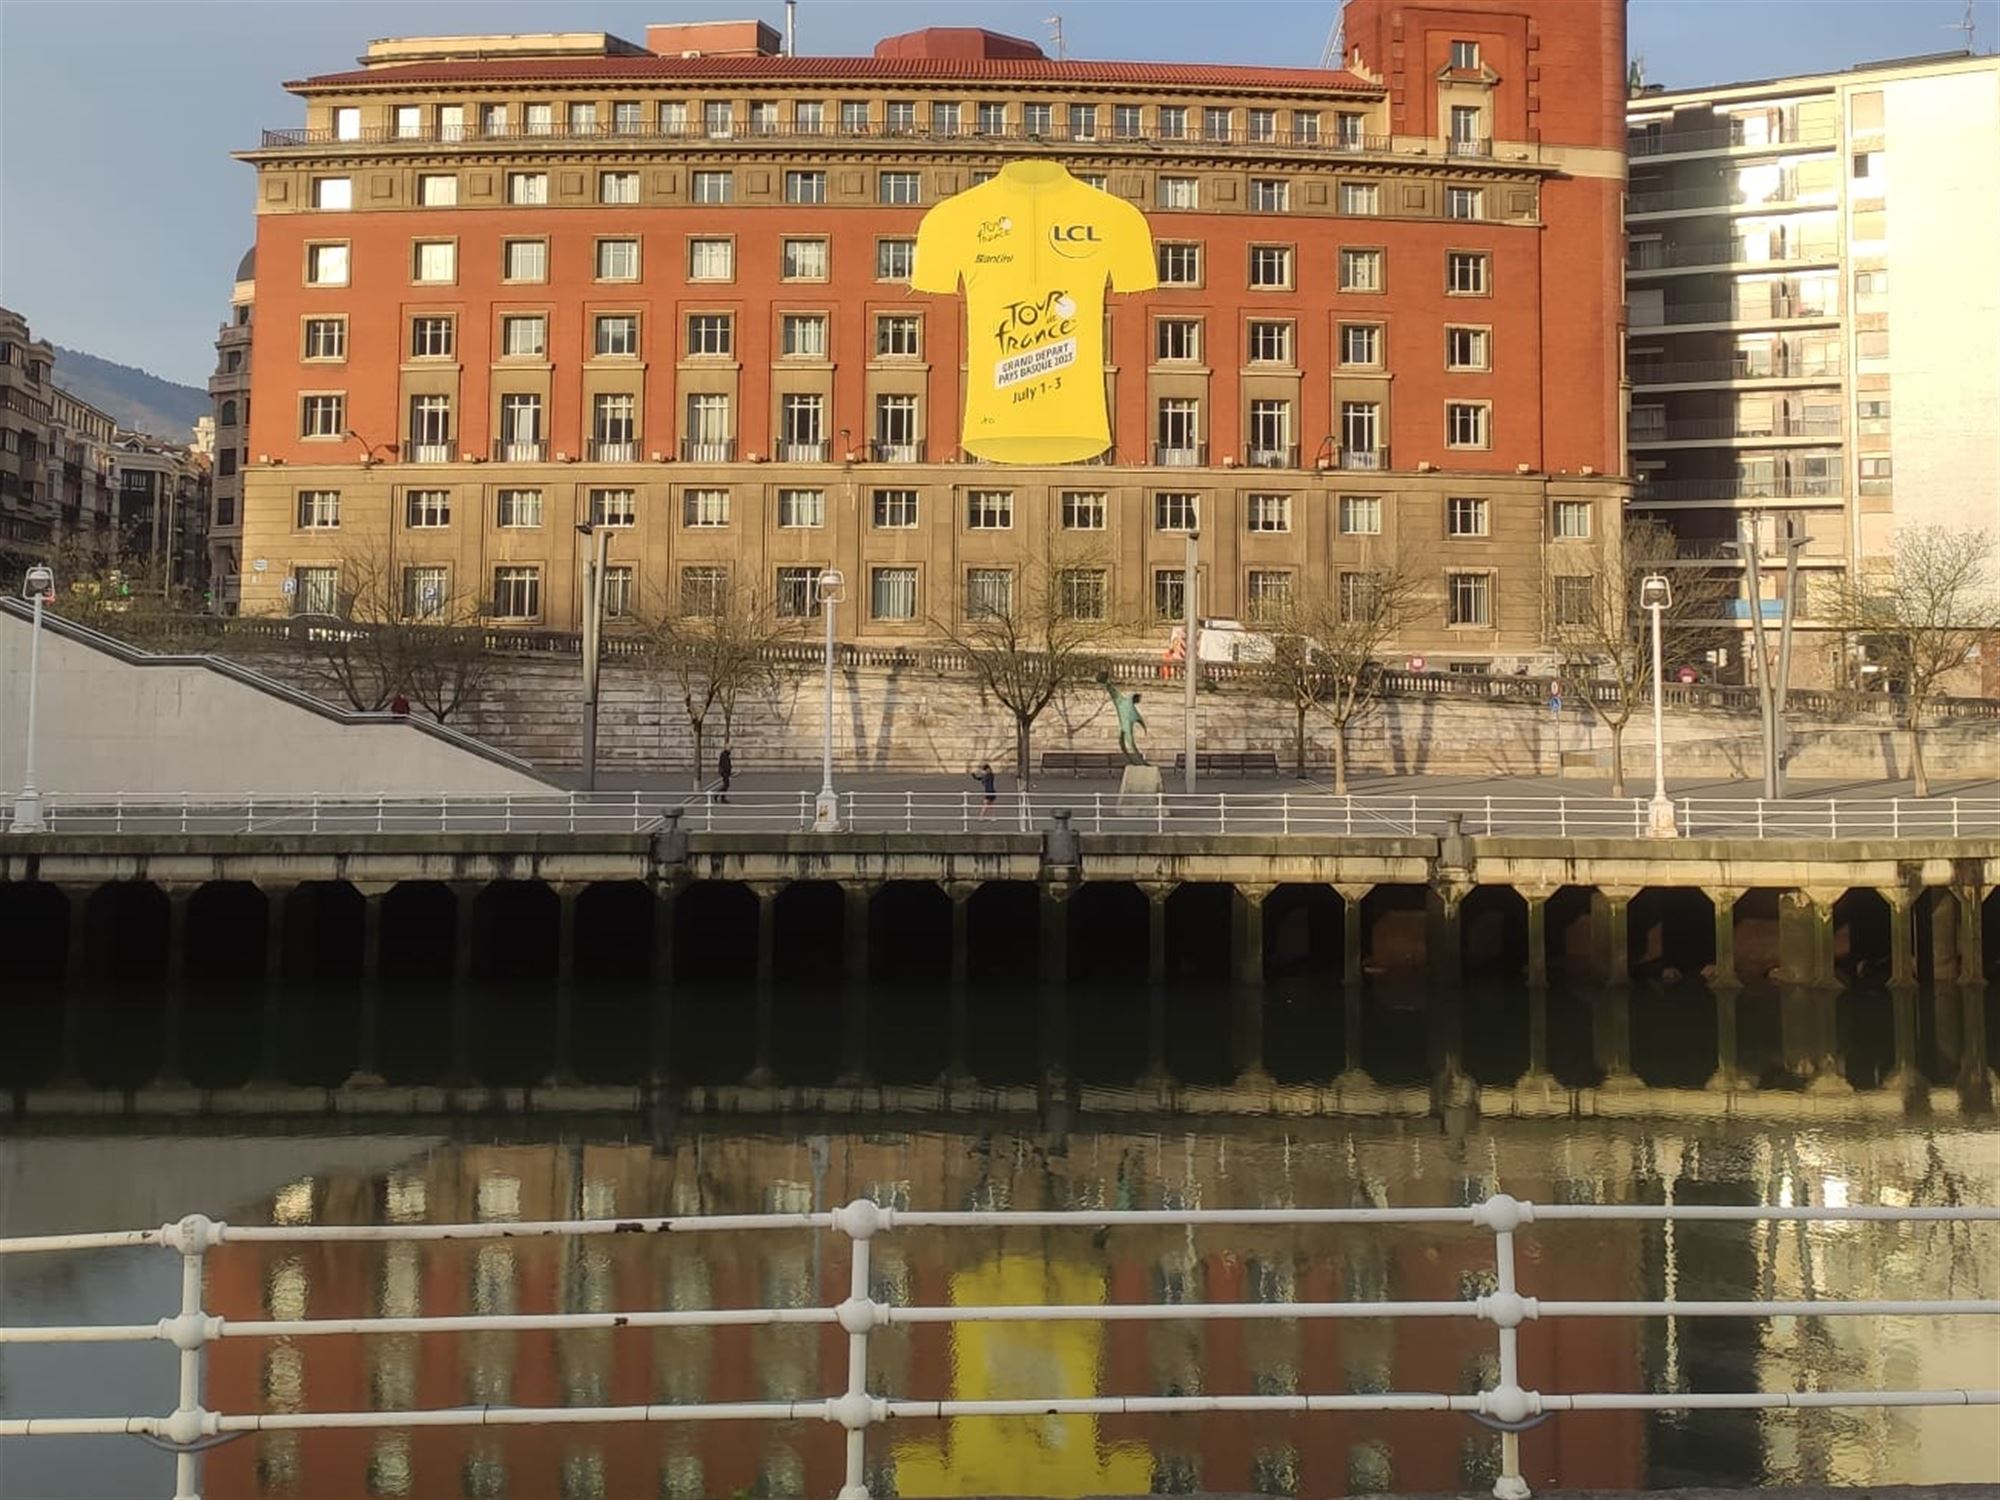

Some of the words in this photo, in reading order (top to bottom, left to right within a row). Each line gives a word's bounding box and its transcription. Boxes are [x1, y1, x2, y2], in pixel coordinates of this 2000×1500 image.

[1054, 225, 1102, 241] LCL
[998, 369, 1019, 385] PAYS
[1020, 358, 1053, 378] BASQUE
[1002, 355, 1033, 373] GRAND
[1012, 386, 1037, 404] July
